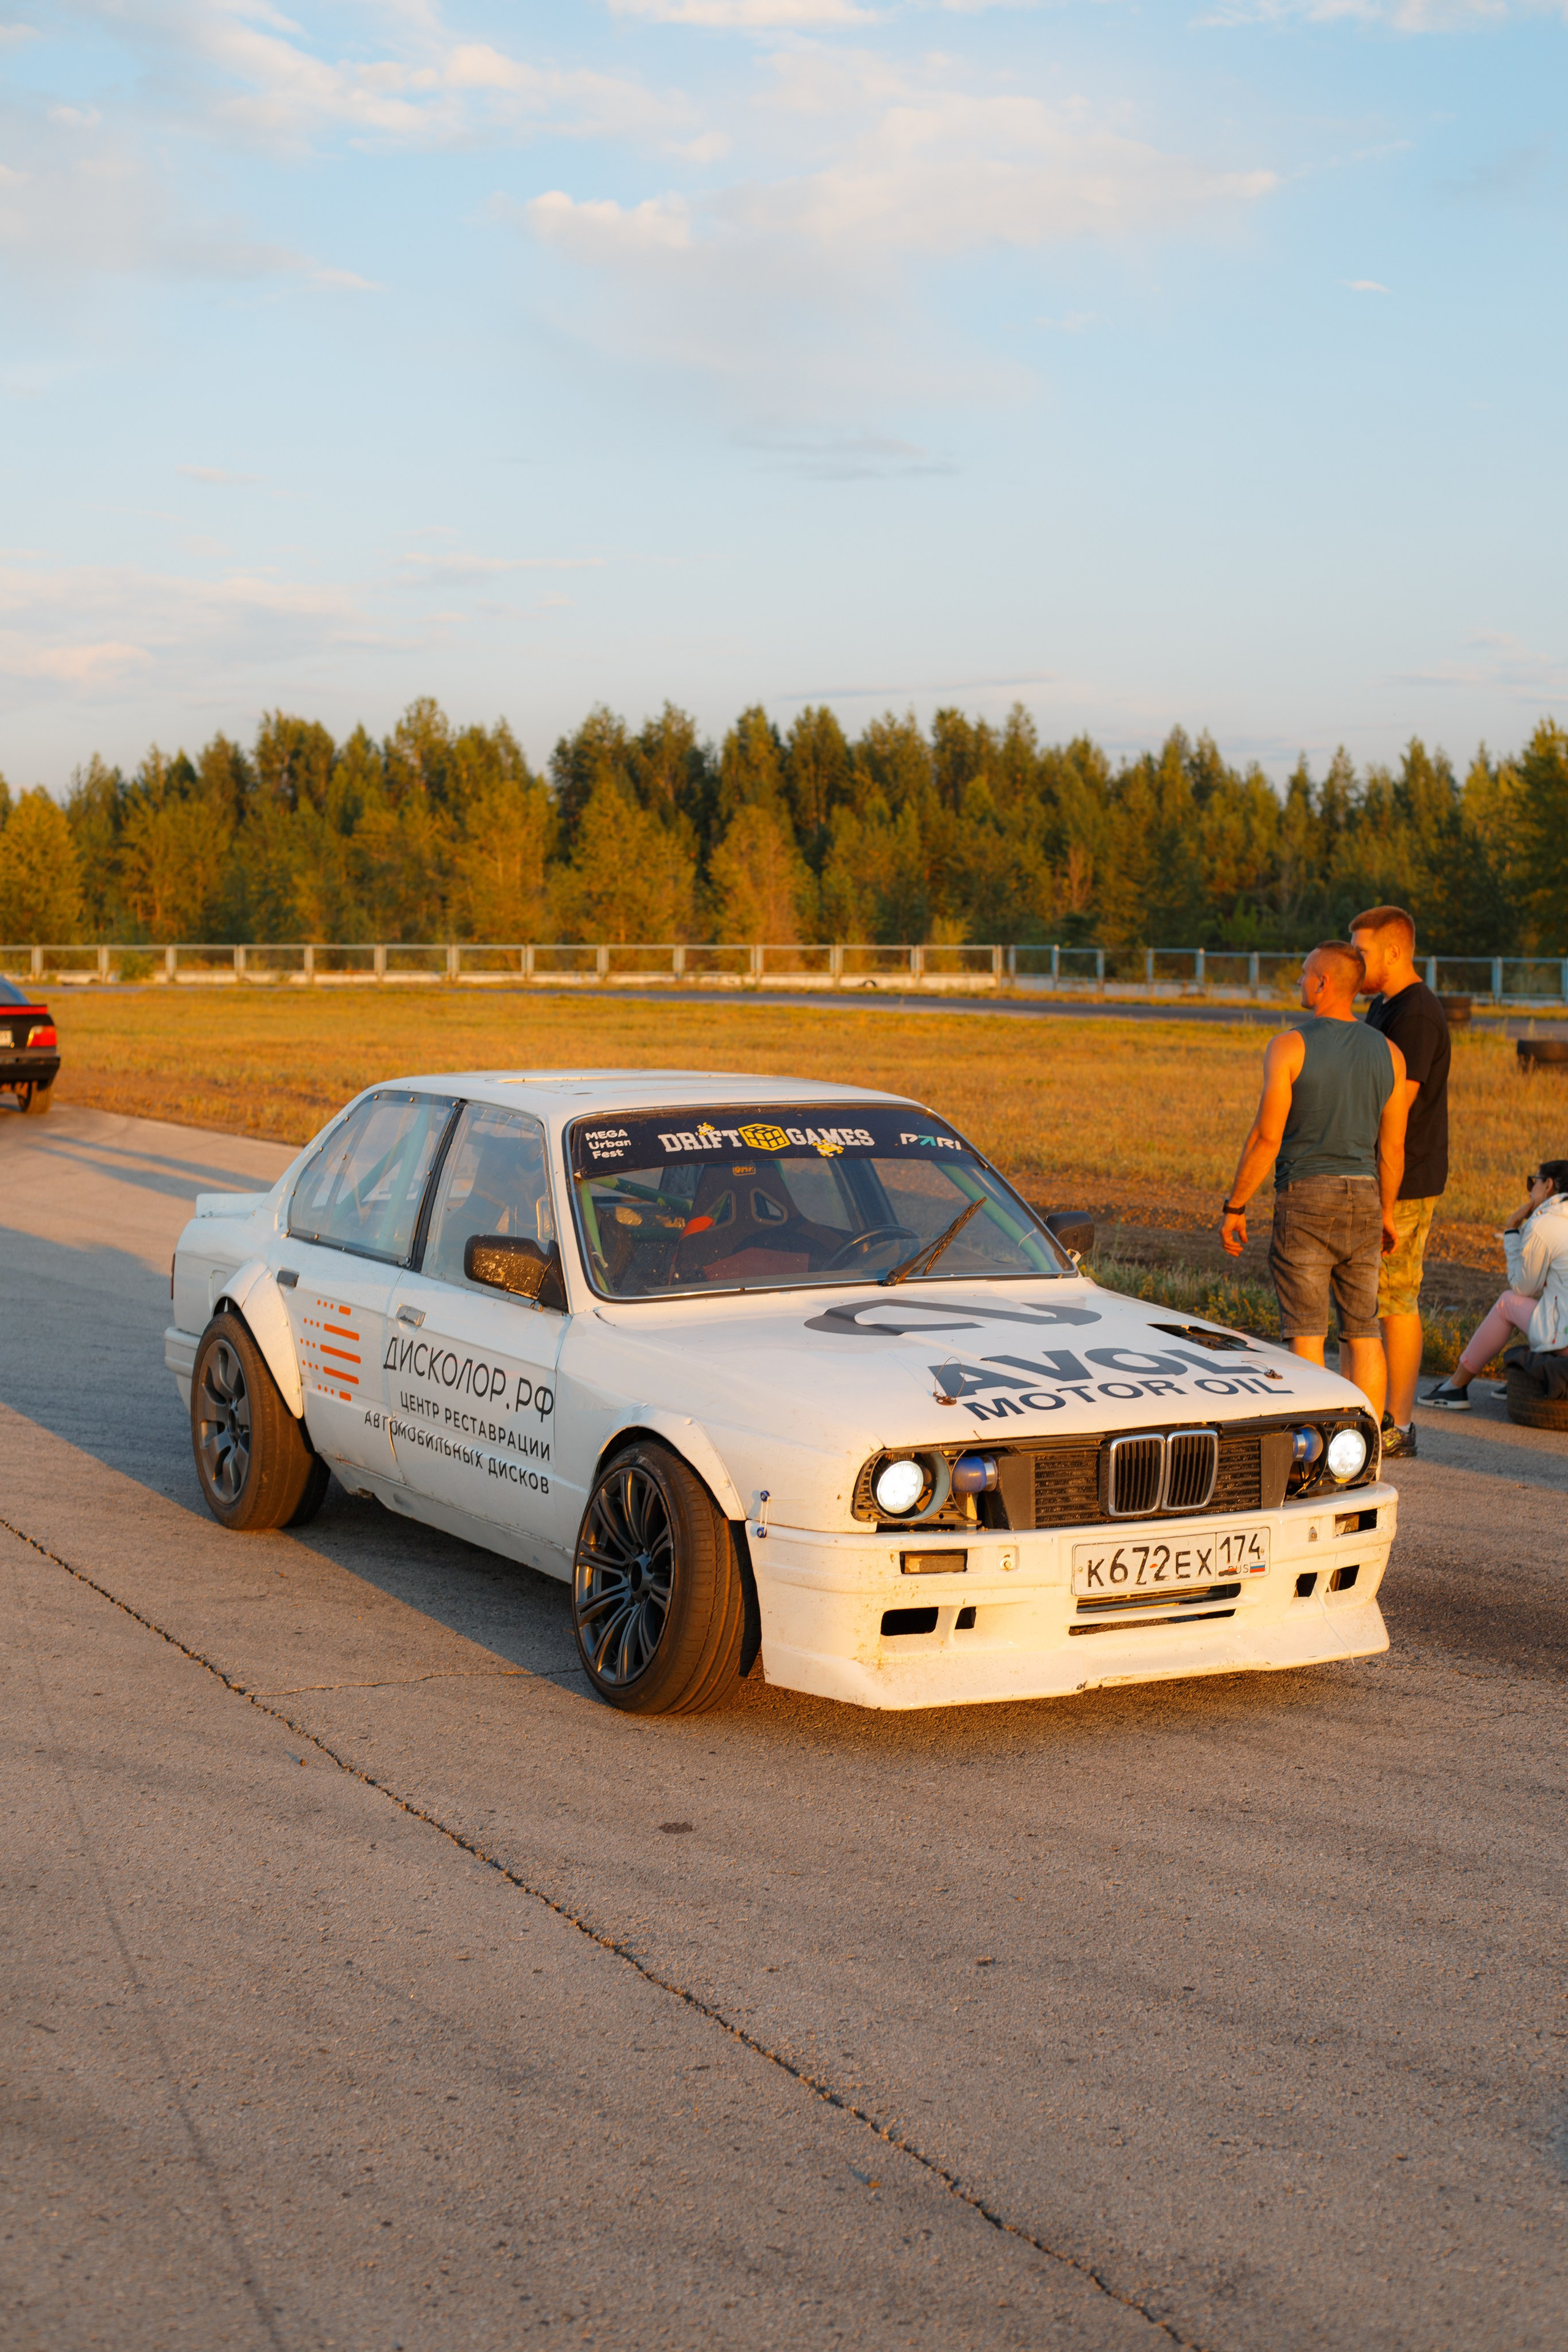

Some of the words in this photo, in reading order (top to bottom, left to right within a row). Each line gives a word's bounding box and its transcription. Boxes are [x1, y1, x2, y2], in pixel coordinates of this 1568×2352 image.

[585, 1129, 628, 1141] MEGA
[588, 1139, 631, 1150] Urban
[592, 1148, 624, 1159] Fest
[785, 1128, 875, 1146] GAMES
[383, 1336, 554, 1423] ДИСКОЛОР.РФ
[927, 1348, 1265, 1398] AVOL
[962, 1380, 1188, 1421] MOTOR
[1194, 1378, 1295, 1395] OIL
[400, 1390, 440, 1419] ЦЕНТР
[445, 1408, 551, 1461] РЕСТАВРАЦИИ
[364, 1410, 483, 1469] АВТОМОБИЛЬНЫХ
[488, 1457, 549, 1494] ДИСКОВ
[1219, 1532, 1261, 1564] 174
